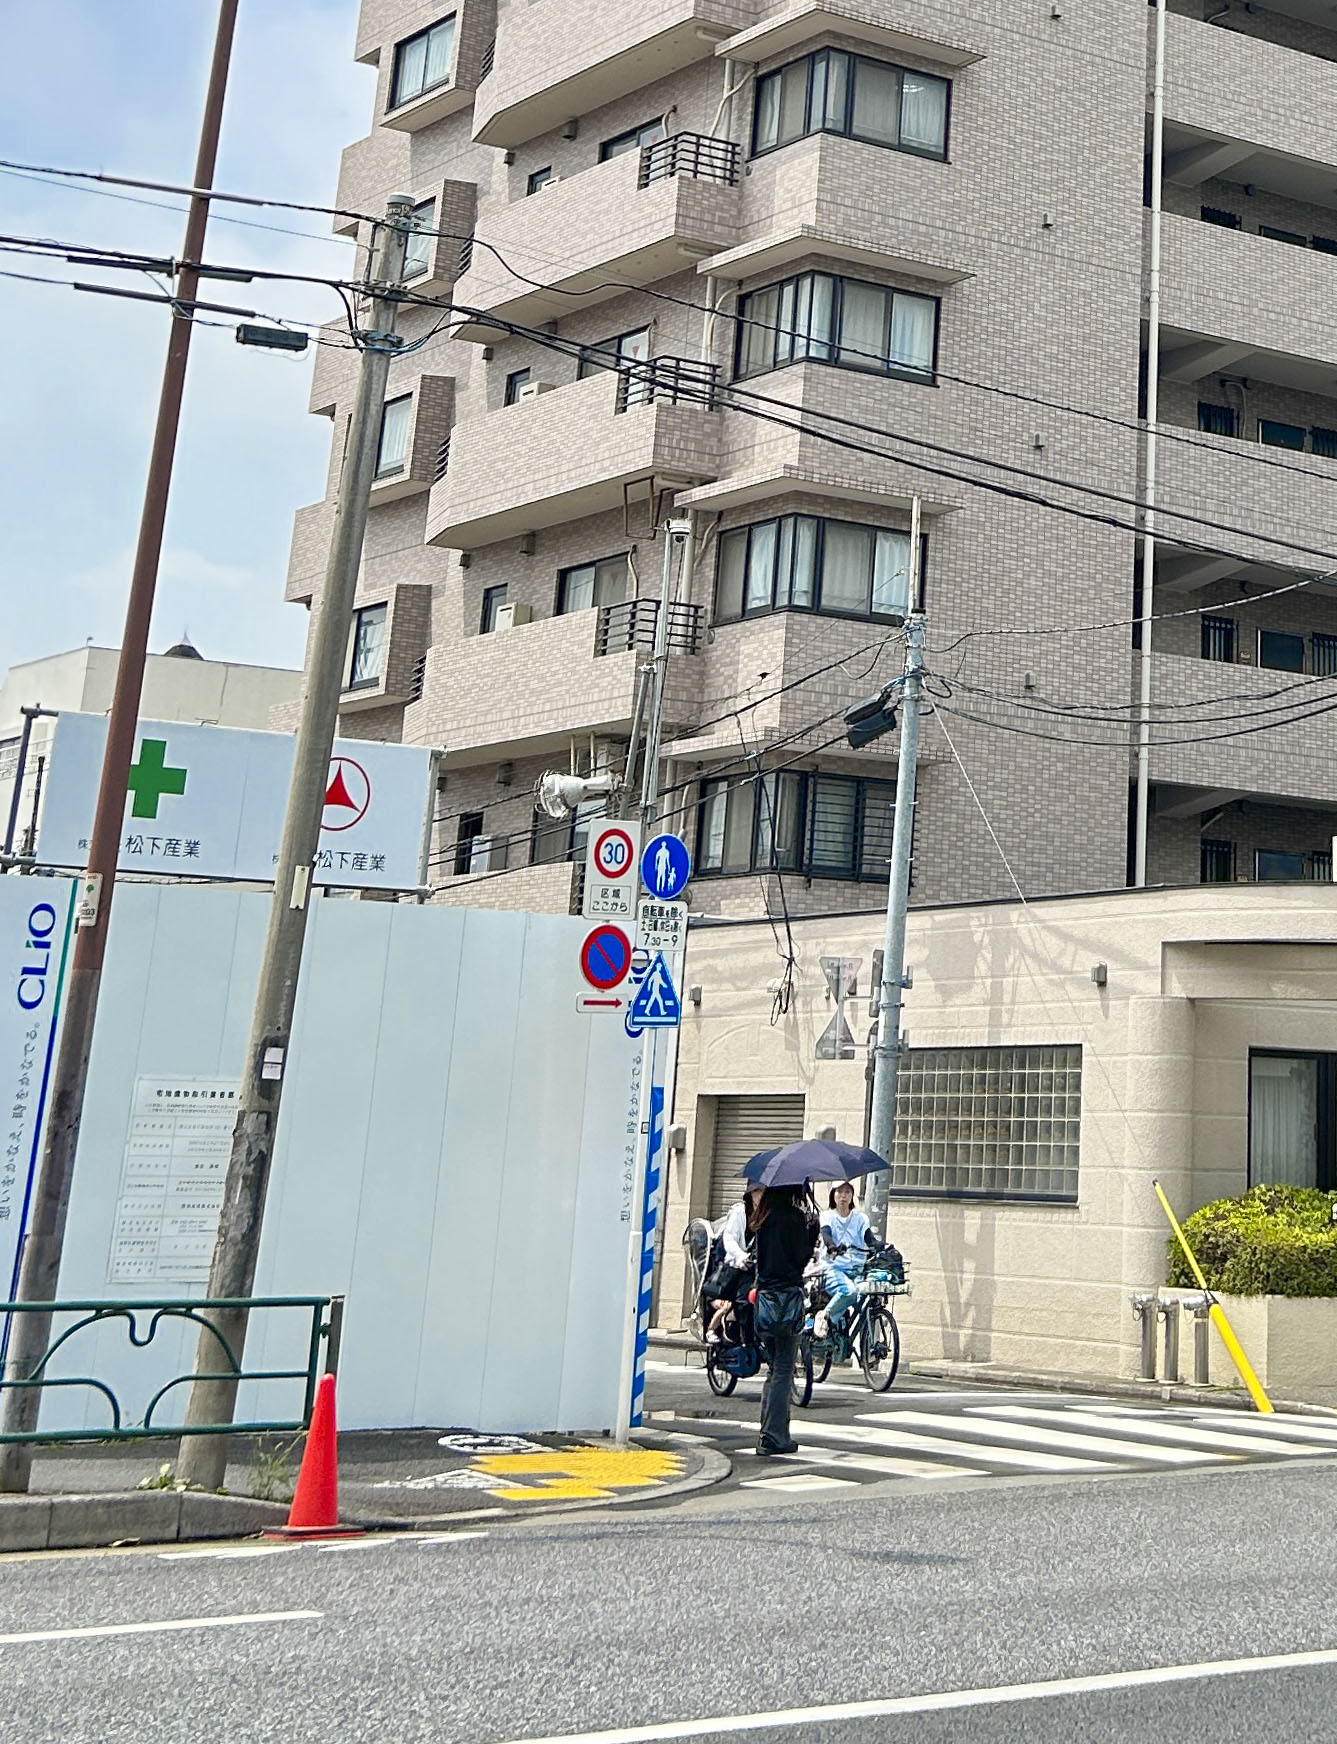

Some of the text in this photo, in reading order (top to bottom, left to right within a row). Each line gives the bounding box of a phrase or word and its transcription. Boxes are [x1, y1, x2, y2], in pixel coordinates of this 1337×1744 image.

[125, 835, 201, 858] 松下産業
[603, 842, 625, 865] 30
[317, 850, 387, 872] 松下産業
[601, 887, 621, 898] 区域
[592, 901, 628, 912] ここから
